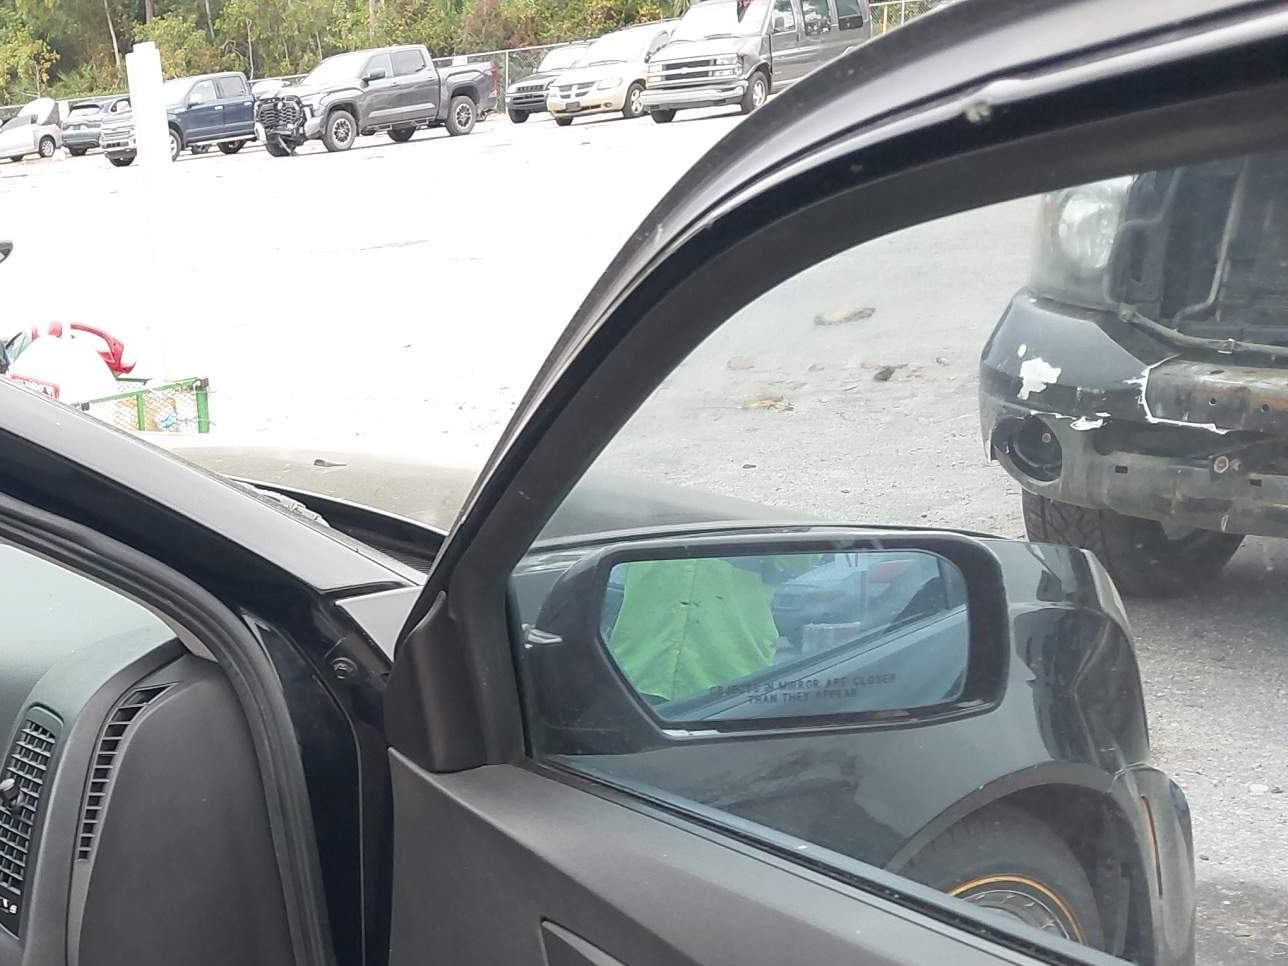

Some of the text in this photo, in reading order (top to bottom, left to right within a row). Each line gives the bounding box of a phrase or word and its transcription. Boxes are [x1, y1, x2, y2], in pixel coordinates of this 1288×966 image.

[778, 679, 819, 691] MIRROR
[826, 677, 848, 688] ARE
[853, 673, 898, 687] CLOSER
[747, 694, 778, 705] THAN
[783, 691, 810, 703] THEY
